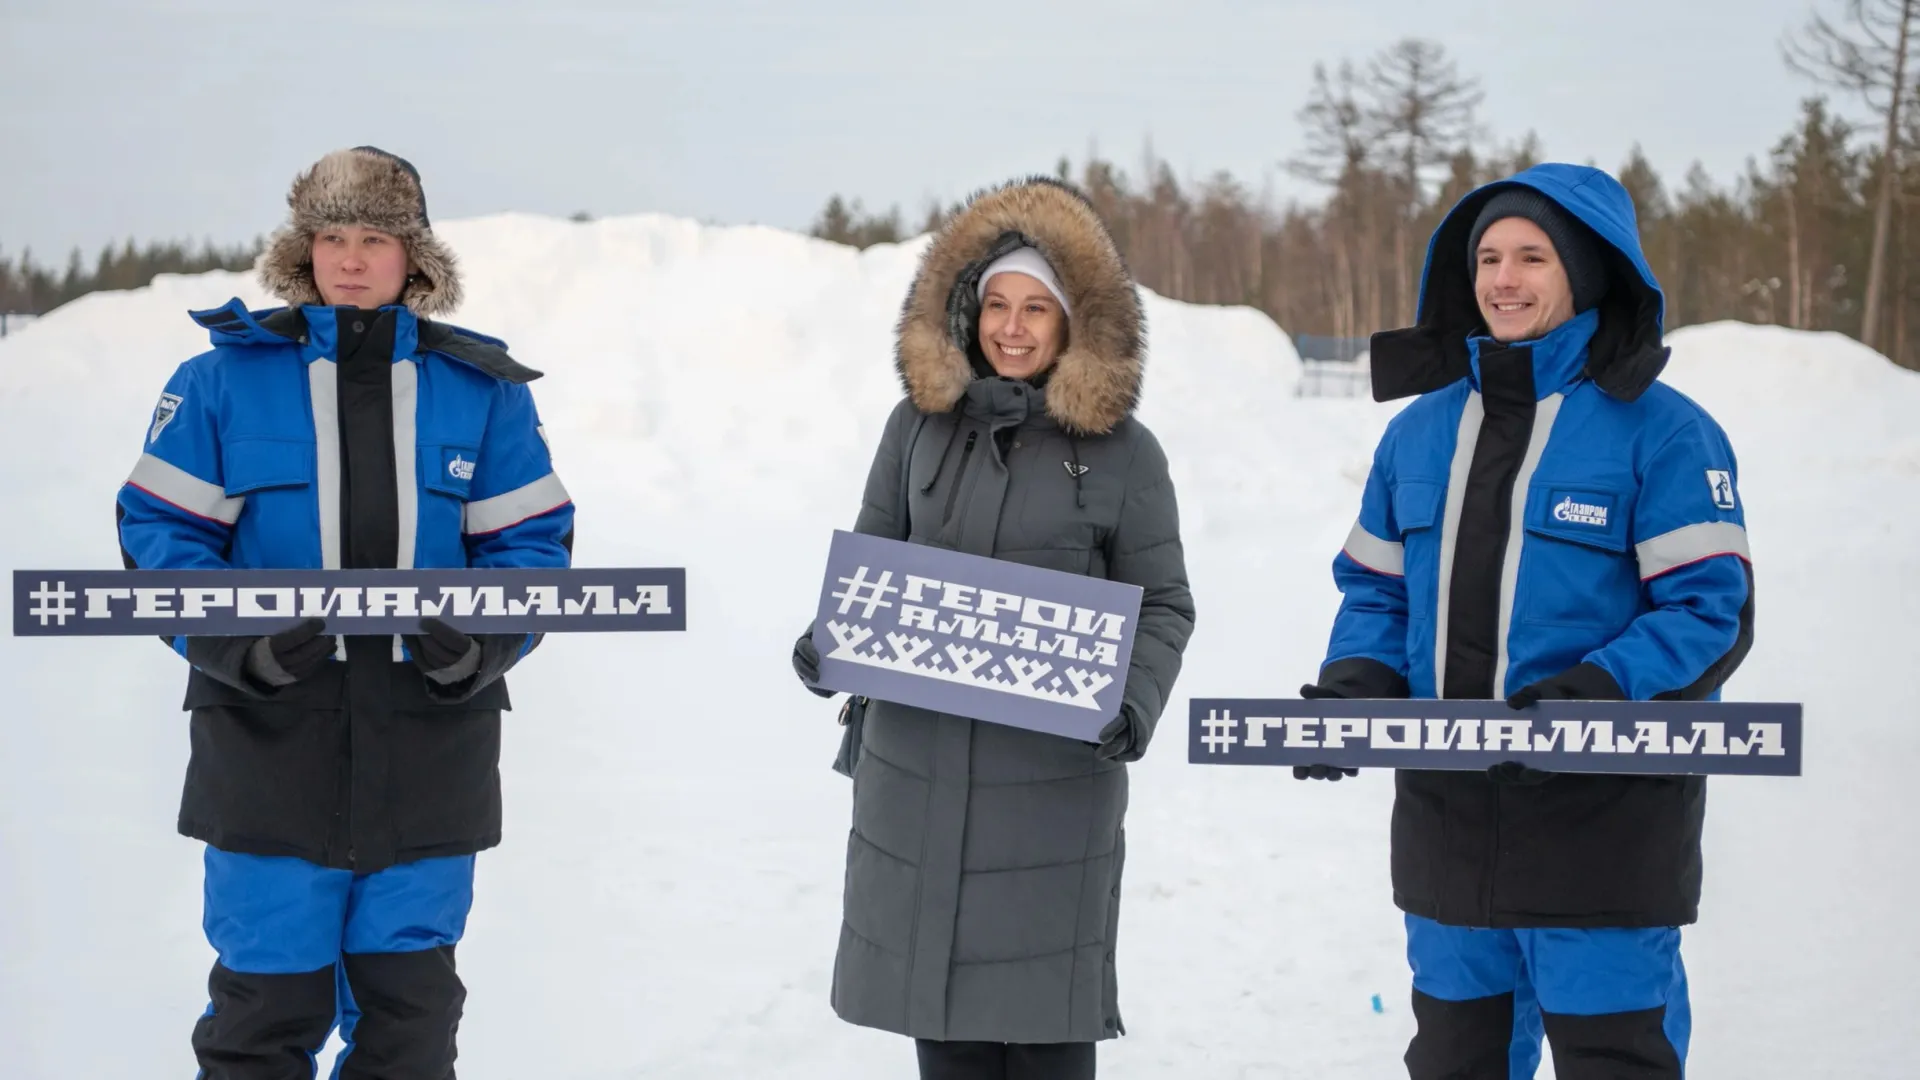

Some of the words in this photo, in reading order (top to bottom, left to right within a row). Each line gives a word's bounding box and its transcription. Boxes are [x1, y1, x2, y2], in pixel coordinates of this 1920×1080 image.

[1570, 503, 1608, 518] ГАЗПРОМ
[29, 580, 672, 626] #ГЕРОИЯМАЛА
[831, 565, 1126, 641] #ГЕРОИ
[898, 603, 1118, 667] ЯМАЛА
[1200, 708, 1786, 756] #ГЕРОИЯМАЛА
